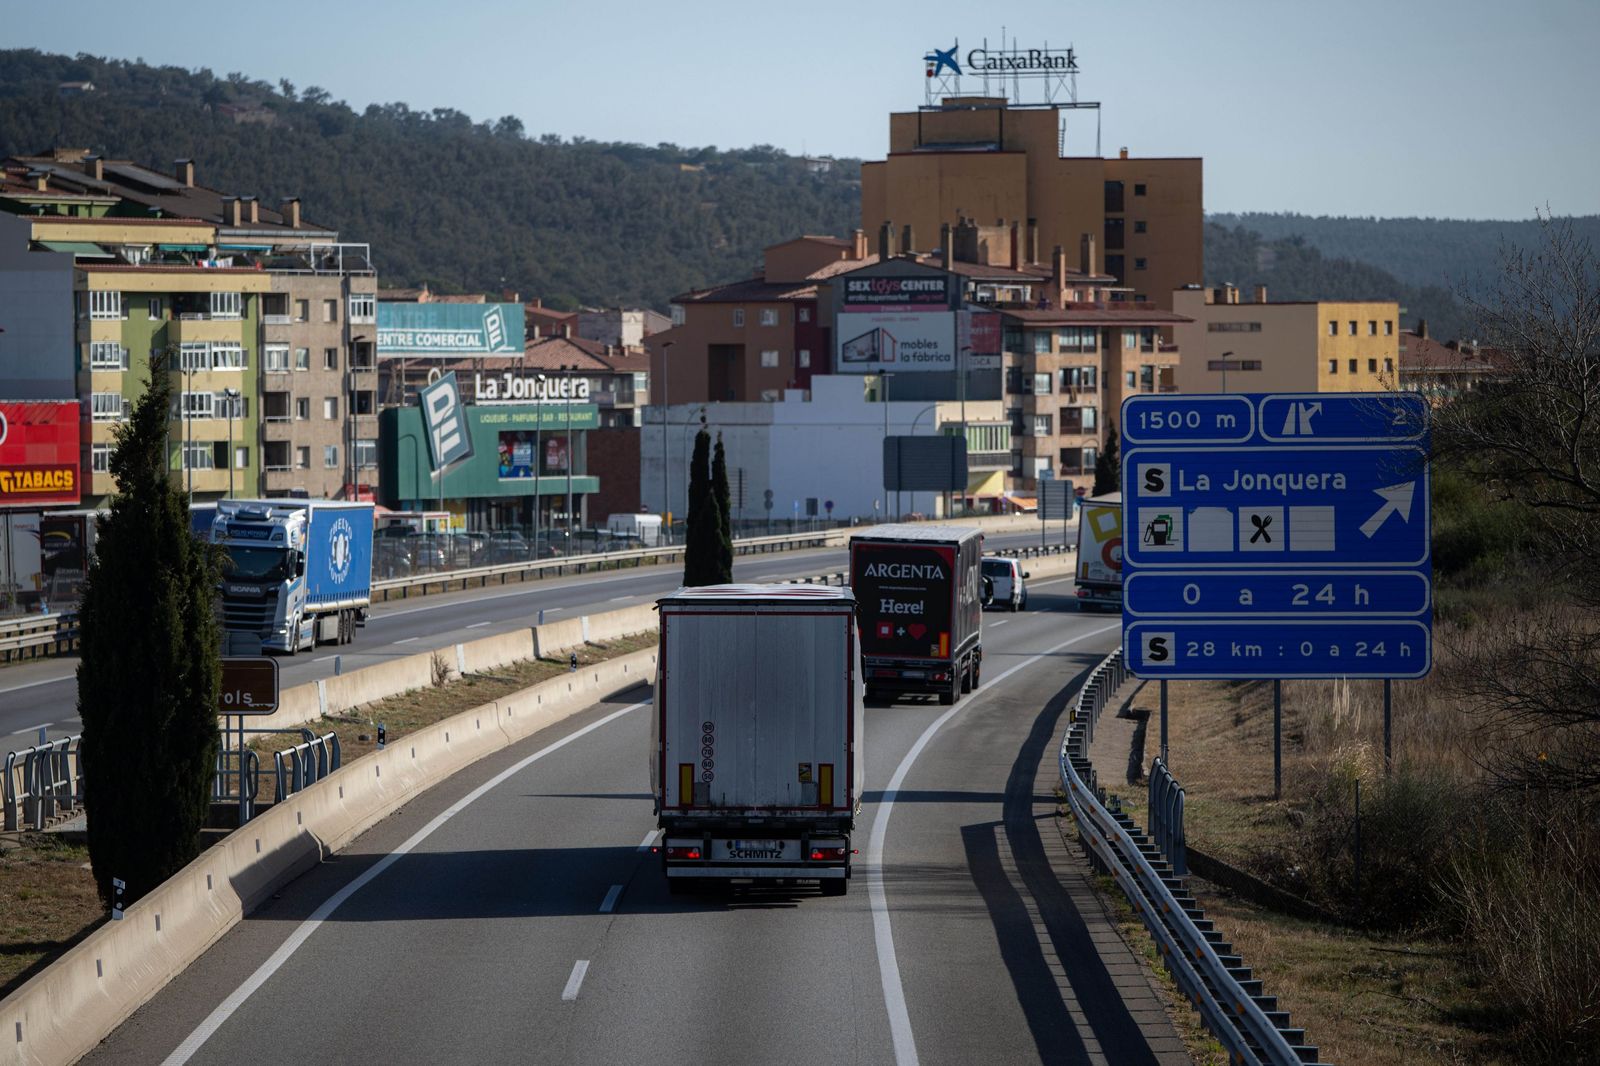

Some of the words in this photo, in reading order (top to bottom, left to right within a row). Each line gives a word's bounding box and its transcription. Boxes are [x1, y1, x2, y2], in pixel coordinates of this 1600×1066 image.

[967, 49, 1080, 70] CaixaBank
[848, 280, 871, 291] SEX
[900, 280, 945, 291] CENTER
[415, 333, 482, 346] COMERCIAL
[900, 339, 938, 350] mobles
[900, 351, 910, 362] la
[475, 373, 497, 399] La
[502, 373, 589, 401] Jonquera
[1139, 410, 1201, 430] 1500
[1216, 413, 1236, 428] m
[14, 470, 74, 488] TABACS
[1144, 468, 1164, 493] S
[1179, 470, 1210, 491] La
[1223, 469, 1347, 496] Jonquera
[864, 562, 945, 580] ARGENTA
[229, 585, 261, 593] SCANIA
[1183, 583, 1201, 605] 0
[1239, 590, 1253, 606] a
[1292, 583, 1336, 606] 24
[1354, 583, 1370, 605] h
[879, 598, 925, 615] Here!
[1148, 637, 1169, 662] S
[1186, 641, 1216, 657] 28
[1231, 641, 1263, 657] km
[1300, 641, 1313, 657] 0
[1329, 645, 1340, 657] a
[1355, 641, 1387, 657] 24
[1400, 641, 1411, 657] h
[729, 850, 782, 859] SCHMITZ
